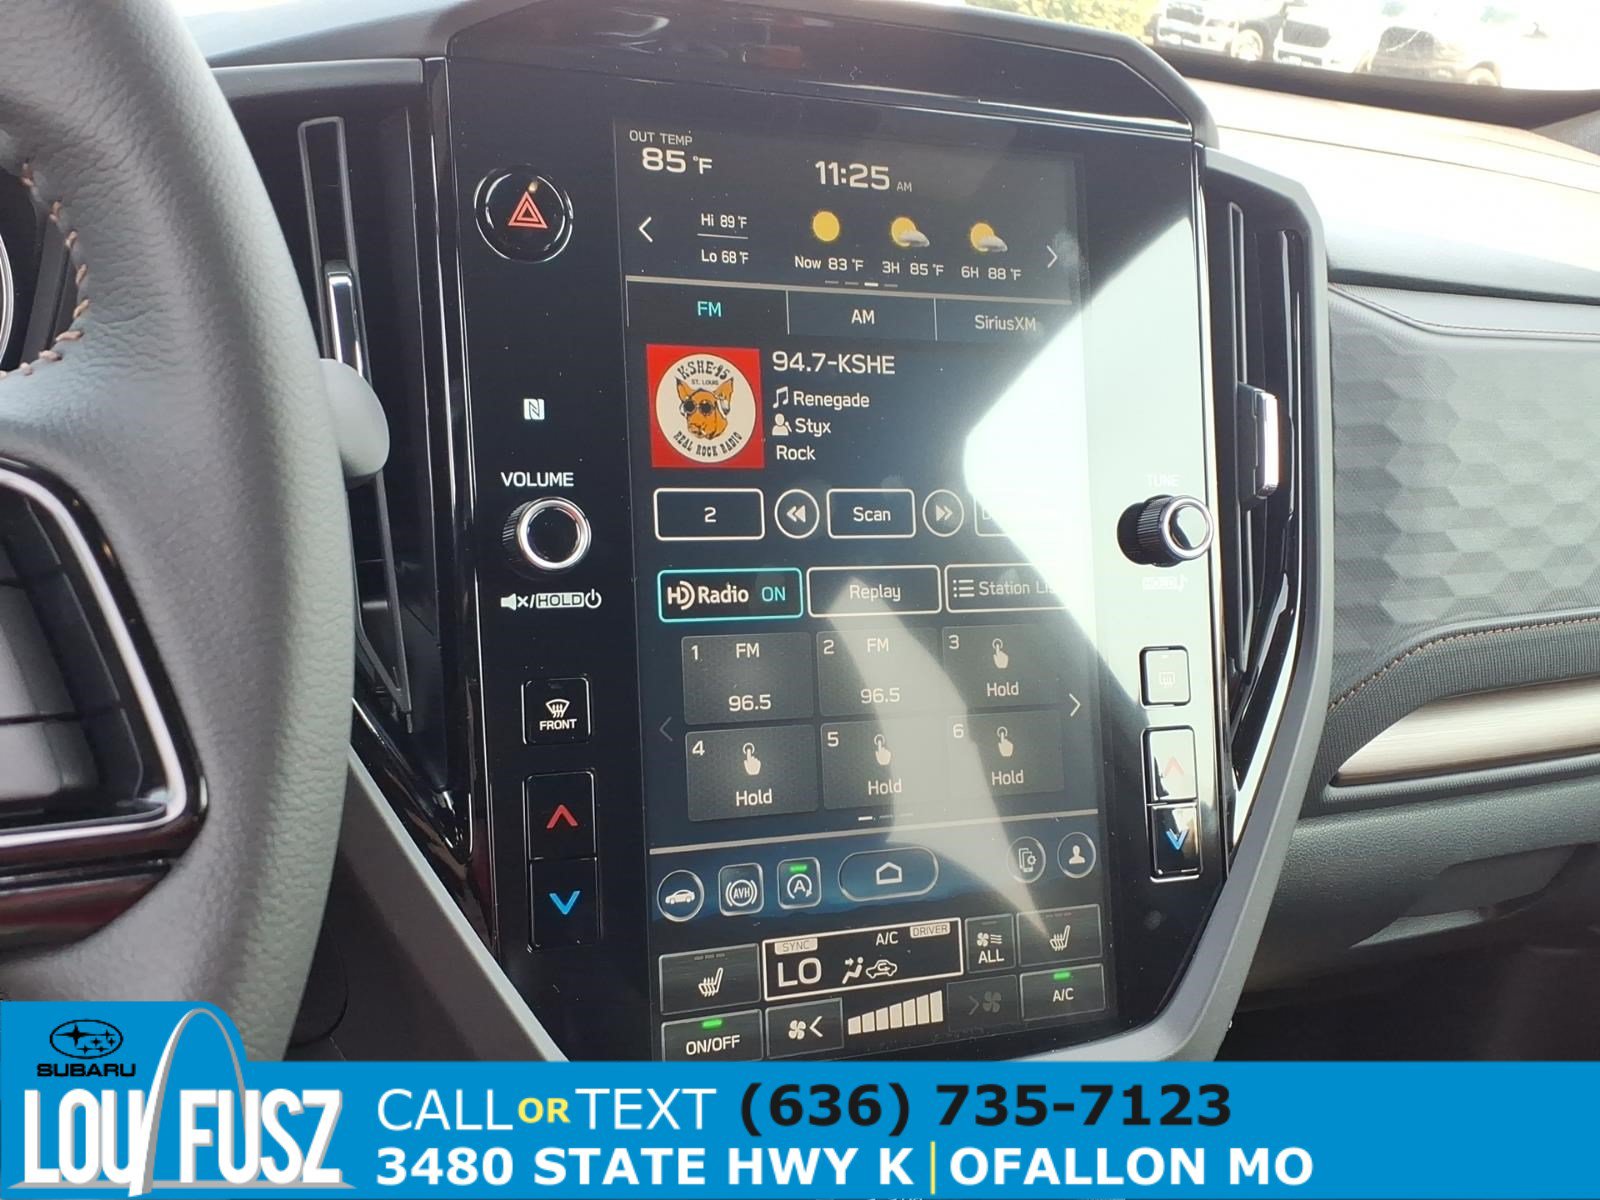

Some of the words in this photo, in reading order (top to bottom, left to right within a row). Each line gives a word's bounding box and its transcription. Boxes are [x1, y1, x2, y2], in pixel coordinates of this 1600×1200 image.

[629, 129, 655, 143] OUT
[660, 132, 693, 146] TEMP
[642, 147, 686, 173] 85
[815, 160, 890, 191] 11:25
[896, 181, 912, 193] AM
[701, 213, 714, 227] Hi
[701, 249, 717, 263] Lo
[794, 256, 821, 269] Now
[882, 261, 900, 275] 3H
[961, 265, 979, 279] 6H
[697, 301, 722, 317] FM
[851, 309, 875, 325] AM
[974, 314, 1036, 332] SiriusXM
[772, 350, 896, 375] 94.7-KSHE
[793, 391, 870, 411] Renegade
[795, 418, 831, 437] Styx
[673, 431, 694, 452] REAL
[695, 444, 718, 457] ROCK
[719, 431, 743, 454] RADIO
[776, 445, 816, 461] Rock
[500, 471, 575, 487] VOLUME
[704, 506, 717, 523] 2
[853, 506, 891, 522] Scan
[761, 586, 786, 602] ON
[849, 584, 902, 602] Replay
[979, 580, 1030, 596] Station
[1035, 580, 1058, 595] Lis
[823, 639, 835, 655] 2
[867, 637, 889, 652] FM
[948, 634, 960, 649] 3
[691, 645, 699, 660] 1
[736, 643, 760, 658] FM
[861, 687, 900, 704] 96.5
[987, 681, 1019, 697] Hold
[728, 694, 772, 712] 96.5
[539, 718, 577, 731] FRONT
[952, 723, 964, 738] 6
[827, 731, 839, 747] 5
[692, 740, 705, 756] 4
[991, 769, 1024, 786] Hold
[868, 778, 903, 796] Hold
[736, 788, 773, 807] Hold
[733, 887, 750, 899] AVH
[875, 931, 899, 946] A/C
[912, 924, 949, 937] DRIVER
[783, 940, 810, 953] SYNC
[978, 949, 1005, 964] ALL
[777, 957, 822, 988] LO
[1052, 987, 1075, 1003] A/C
[686, 1034, 740, 1056] ON/OFF
